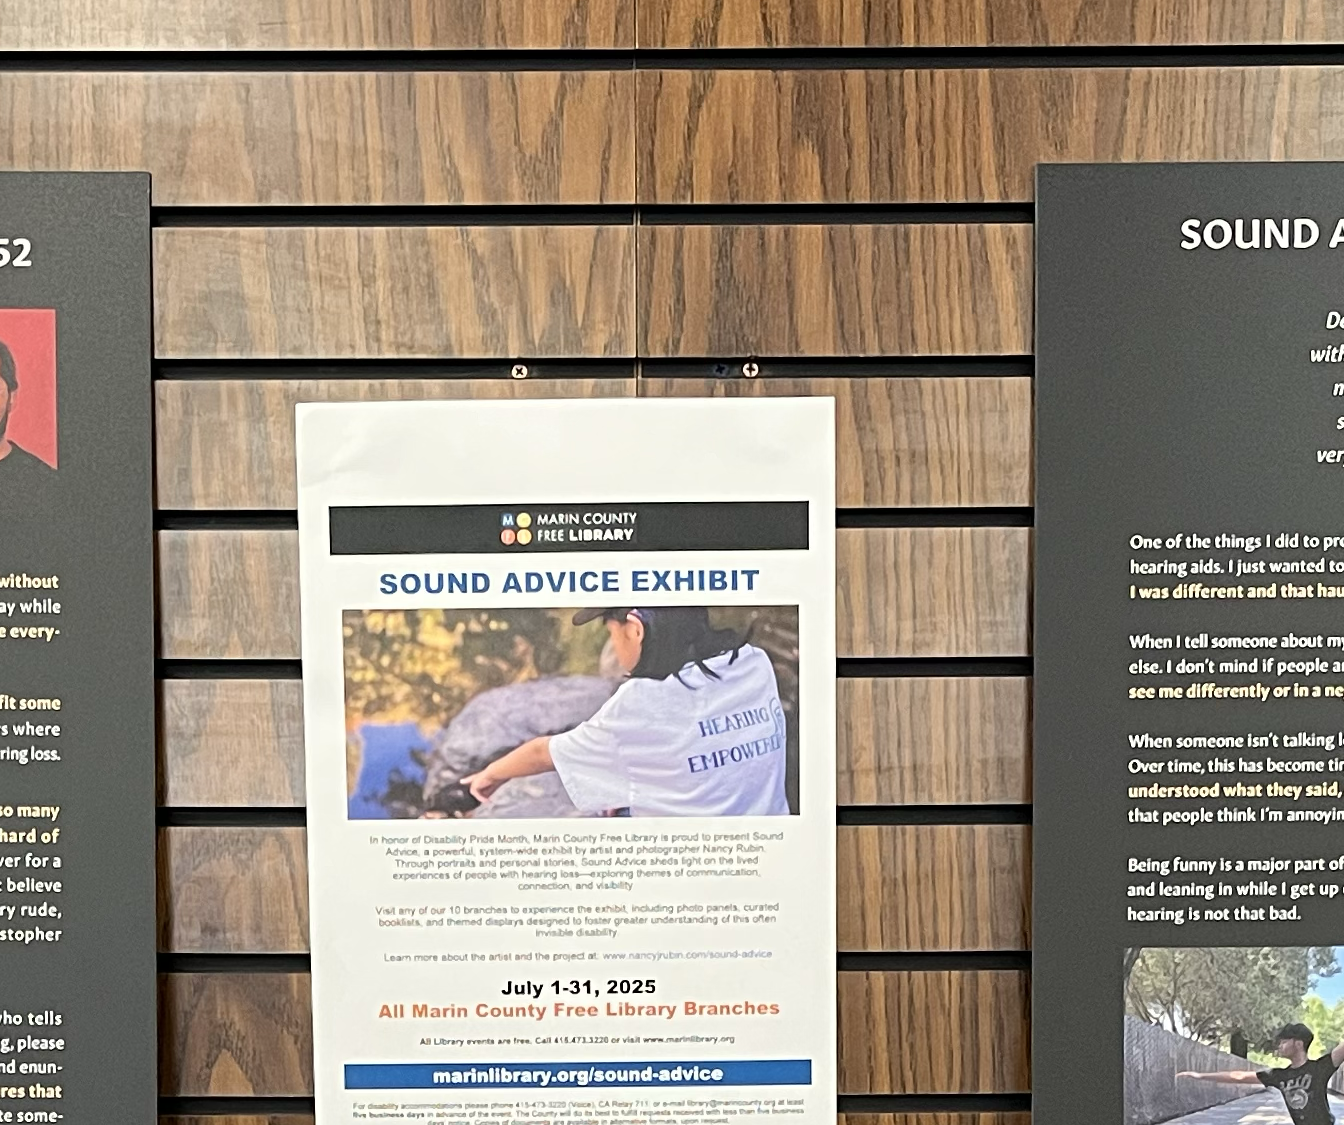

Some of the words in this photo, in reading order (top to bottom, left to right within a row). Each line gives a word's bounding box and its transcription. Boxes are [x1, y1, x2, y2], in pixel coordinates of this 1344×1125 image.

[1181, 217, 1319, 249] SOUND
[537, 513, 579, 525] MARIN
[583, 513, 637, 525] COUNTY
[537, 529, 564, 541] FREE
[569, 529, 634, 541] LIBRARY
[379, 572, 491, 595] SOUND
[502, 570, 620, 594] ADVICE
[631, 569, 760, 592] EXHIBIT
[698, 707, 769, 737] HEARING
[1128, 907, 1184, 925] hearing
[1189, 907, 1201, 921] is
[1205, 909, 1230, 921] not
[1234, 906, 1266, 921] that
[1270, 905, 1302, 921] bad.
[501, 980, 544, 999] July
[551, 979, 600, 998] 1-31,
[607, 979, 656, 995] 2025
[378, 1004, 404, 1019] All
[412, 1004, 468, 1018] Marin
[476, 1003, 547, 1021] County
[554, 1003, 599, 1017] Free
[606, 1002, 677, 1020] Library
[684, 1001, 780, 1016] Branches
[433, 1064, 724, 1086] marinlibrary.org/sound-advice
